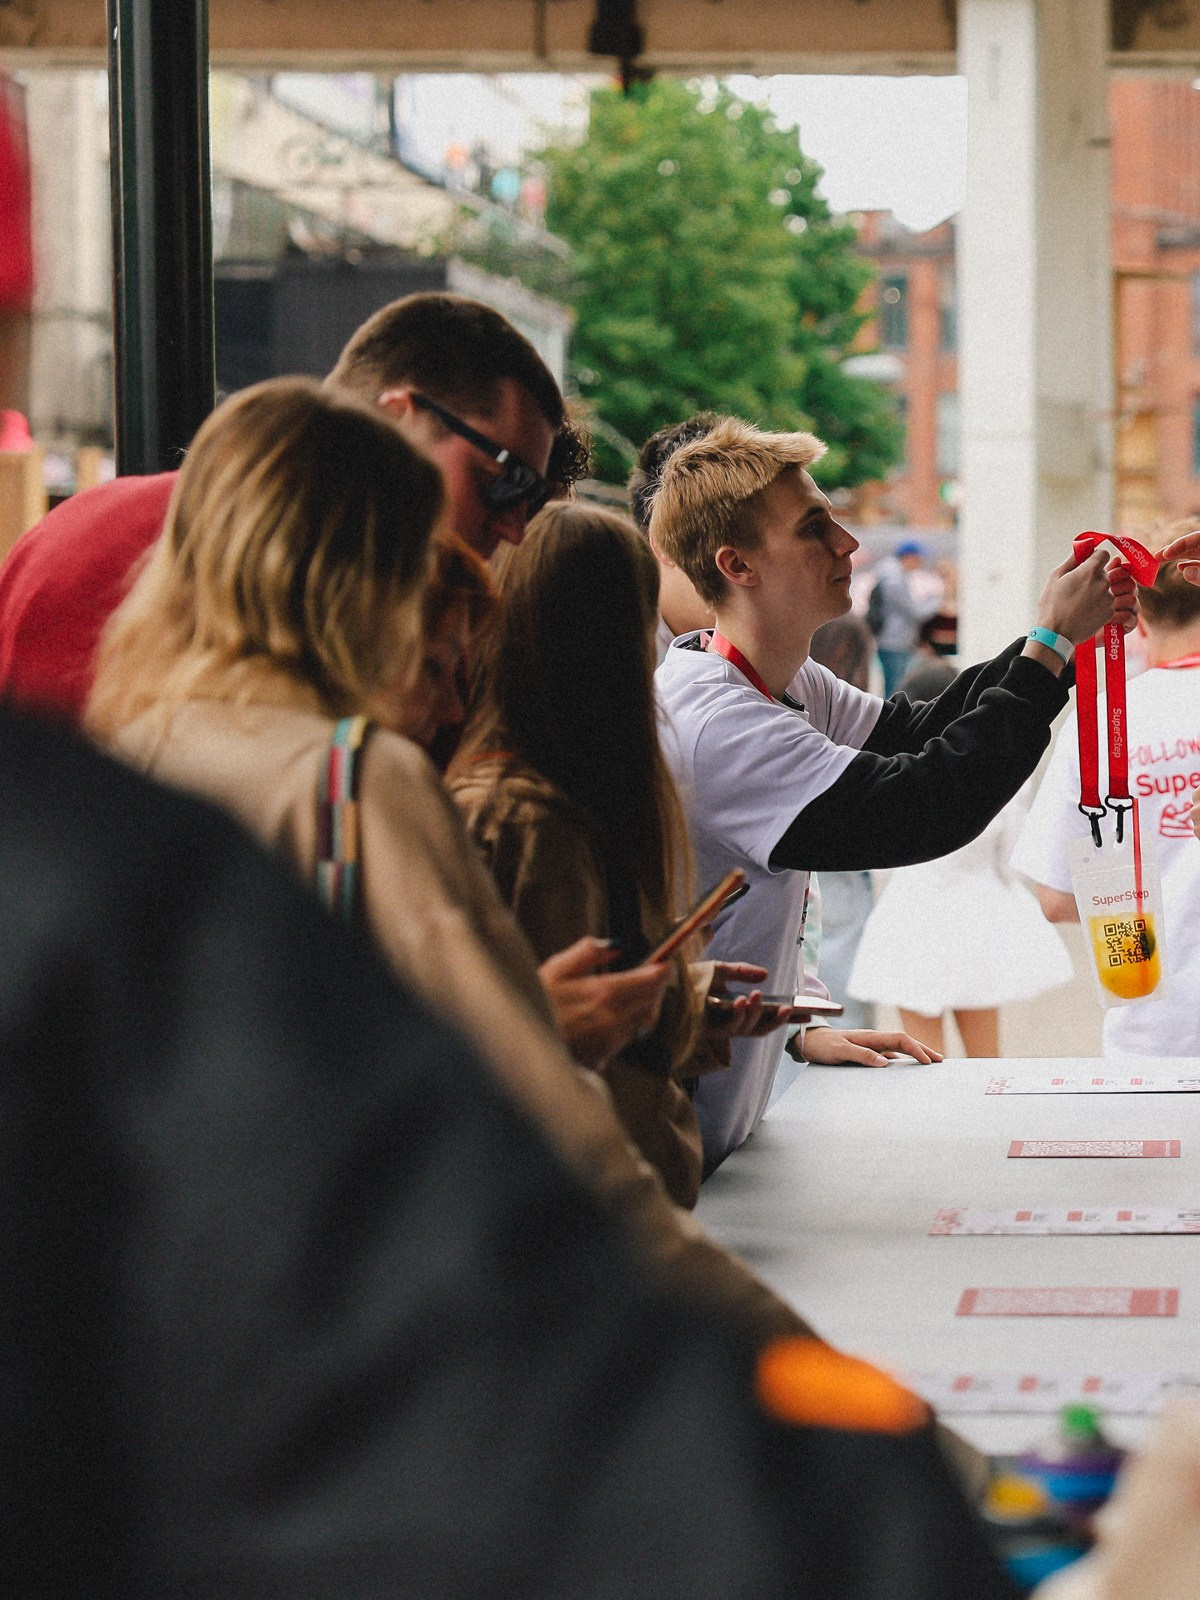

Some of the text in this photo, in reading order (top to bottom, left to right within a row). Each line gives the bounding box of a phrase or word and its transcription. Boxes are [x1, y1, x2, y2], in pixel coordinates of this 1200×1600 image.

[1114, 534, 1149, 568] SuperStep
[1112, 707, 1122, 759] SuperStep
[1092, 890, 1150, 906] SuperStep
